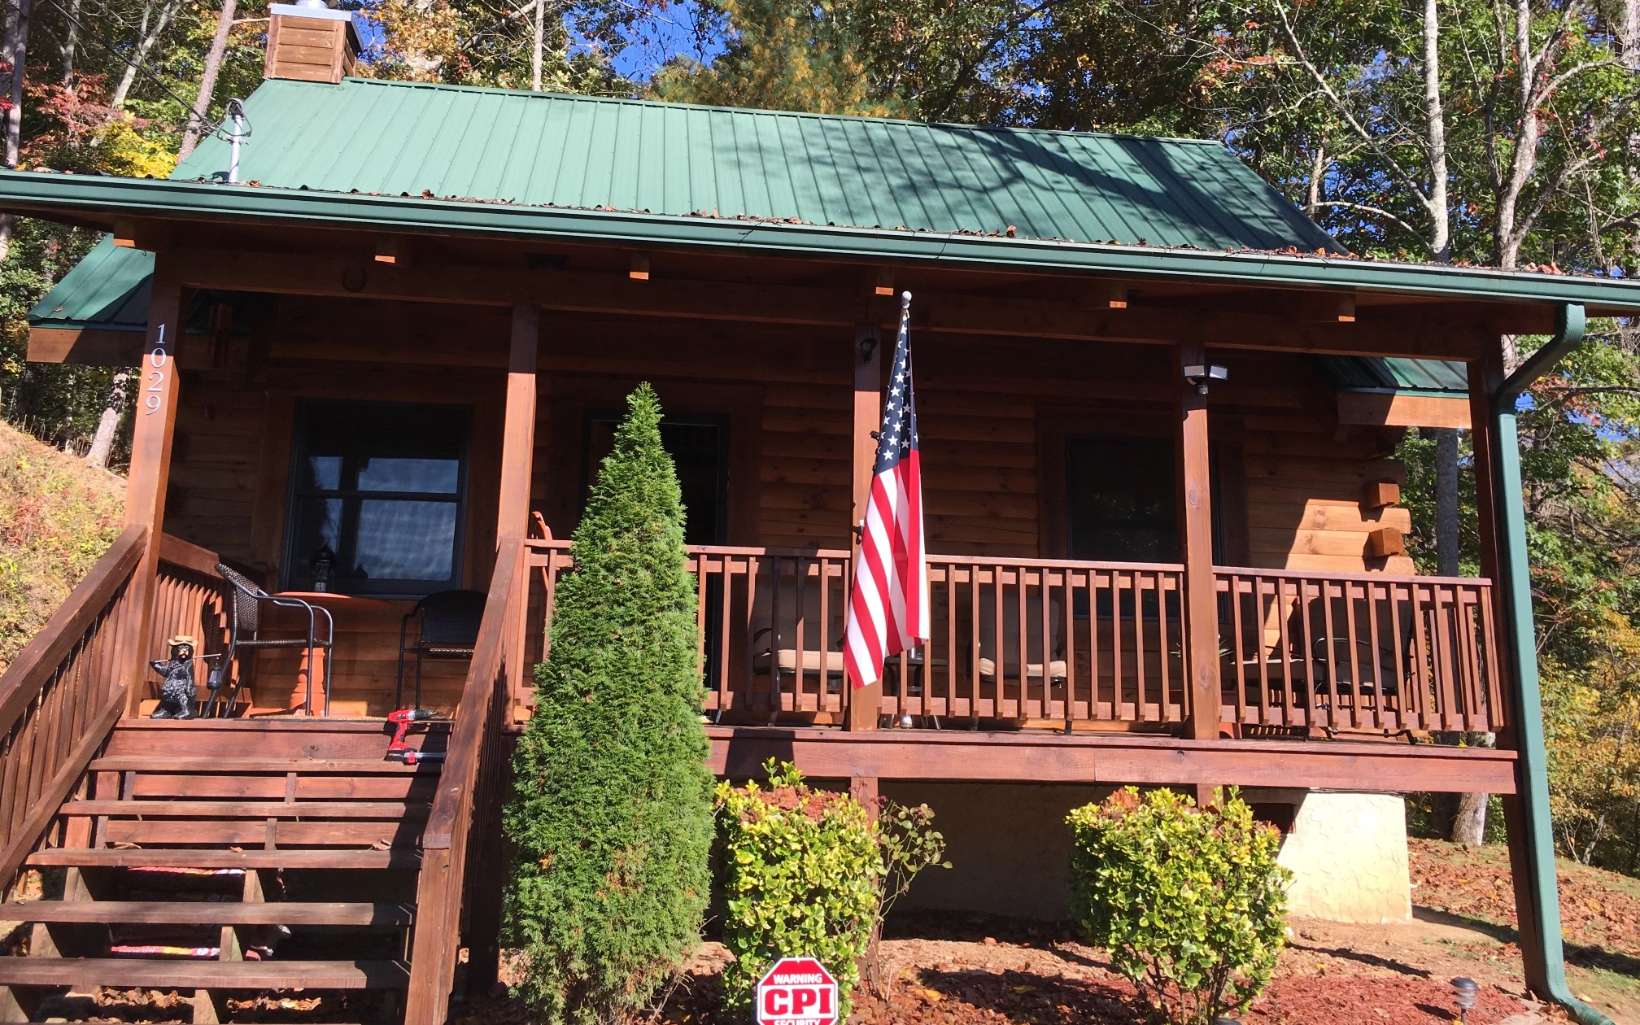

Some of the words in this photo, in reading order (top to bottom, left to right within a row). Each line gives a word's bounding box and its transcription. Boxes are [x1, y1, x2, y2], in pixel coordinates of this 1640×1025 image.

[145, 323, 167, 416] 1029
[773, 973, 822, 984] WARNING
[764, 988, 831, 1015] CPI
